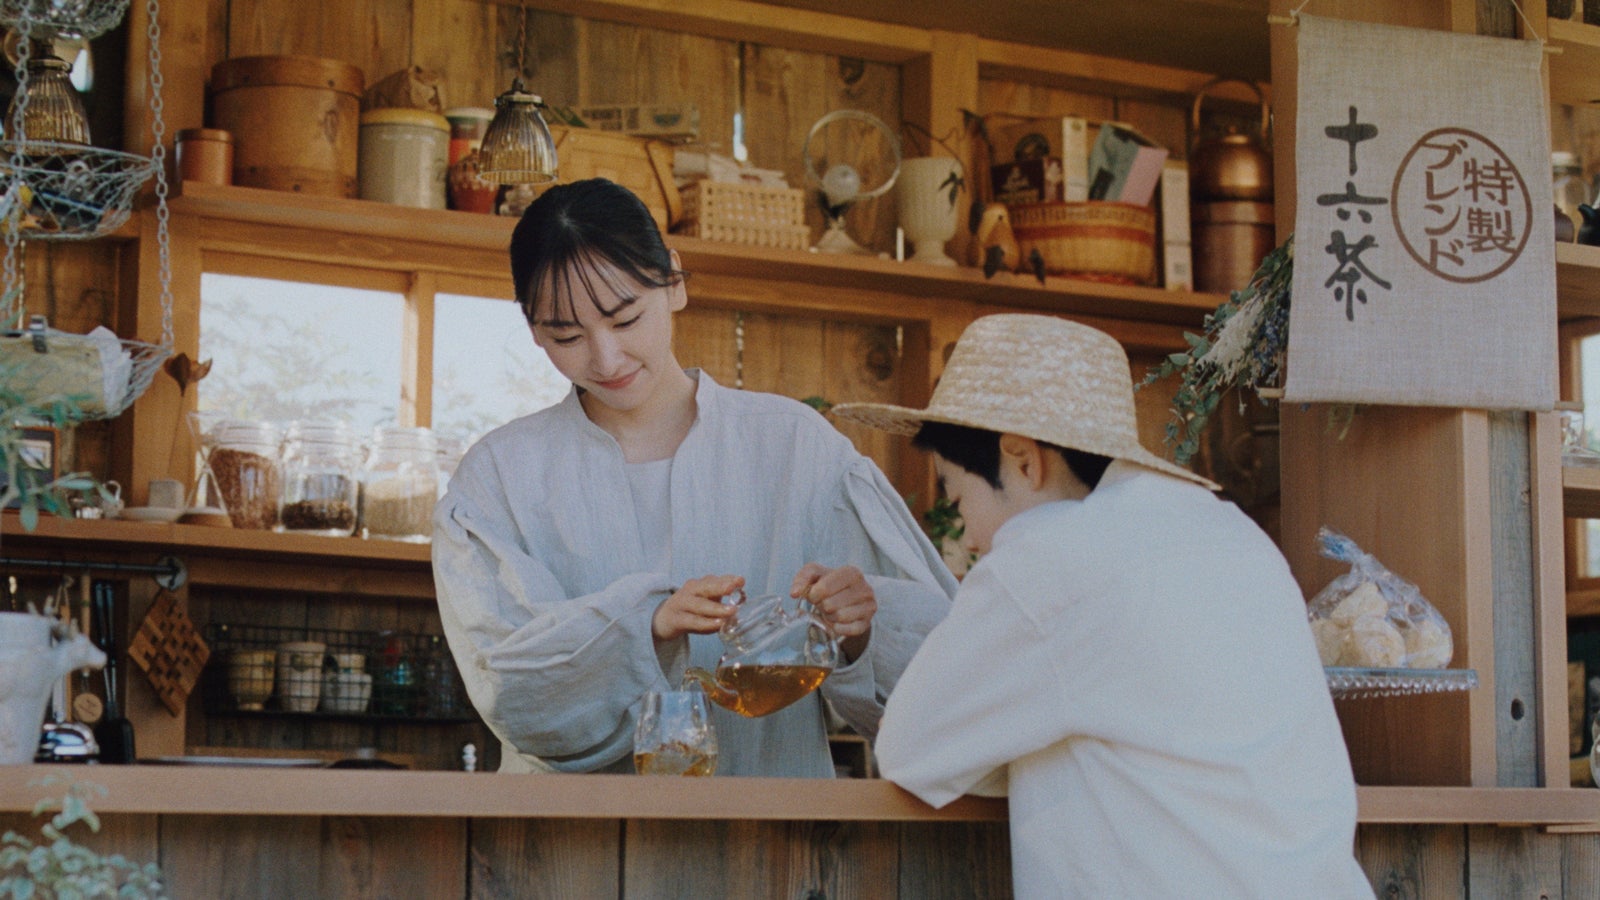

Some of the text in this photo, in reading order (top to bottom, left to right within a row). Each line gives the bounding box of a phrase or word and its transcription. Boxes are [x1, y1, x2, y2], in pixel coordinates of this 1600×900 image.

[1316, 105, 1392, 322] 十六茶
[1420, 139, 1468, 271] ブレンド
[1463, 157, 1517, 254] 特製
